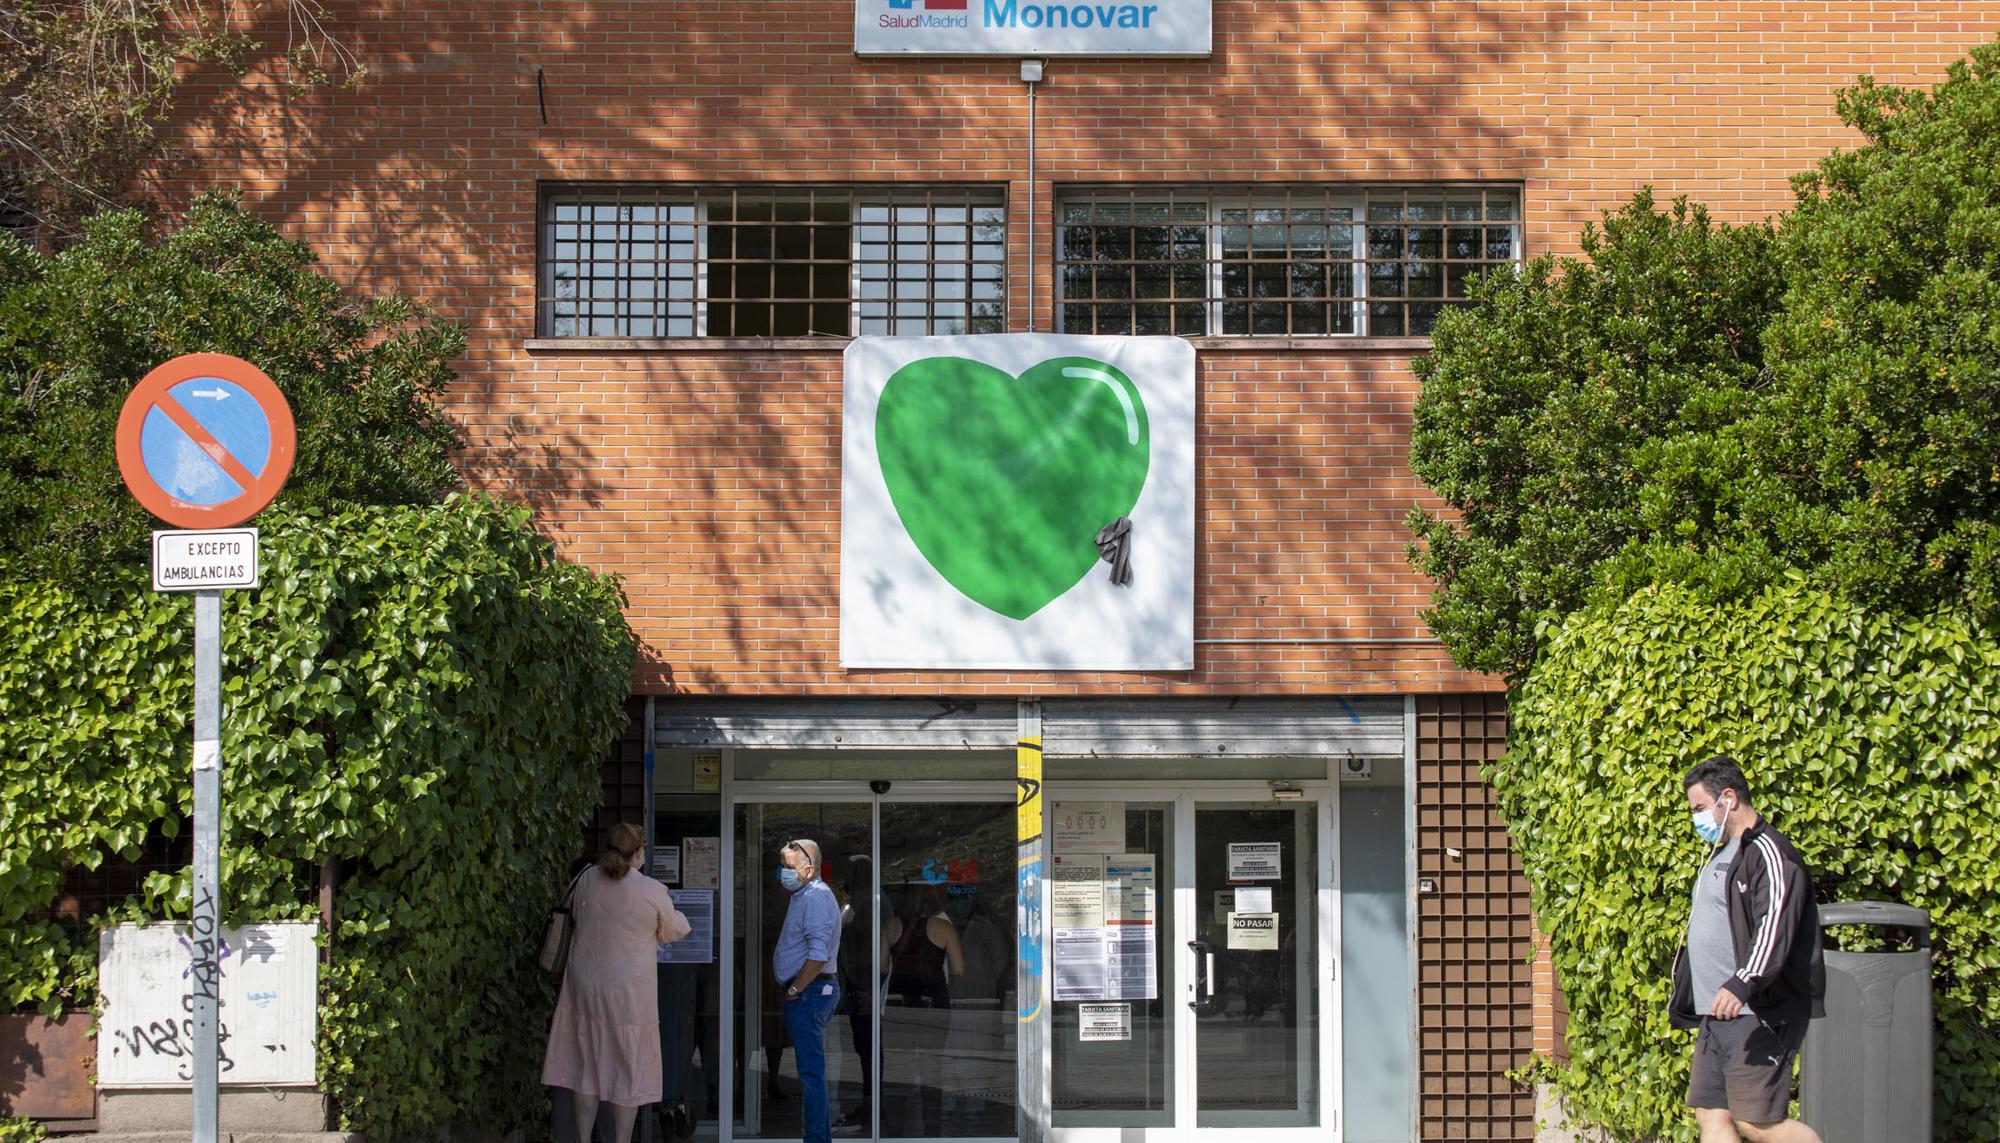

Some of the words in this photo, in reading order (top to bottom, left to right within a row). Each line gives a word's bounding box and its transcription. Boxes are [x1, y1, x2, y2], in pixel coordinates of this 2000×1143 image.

[879, 14, 967, 28] SaludMadrid
[984, 0, 1157, 28] Monovar
[188, 542, 240, 555] EXCEPTO
[164, 565, 244, 579] AMBULANCIAS
[1233, 919, 1246, 927] NO
[1247, 919, 1273, 927] PASAR
